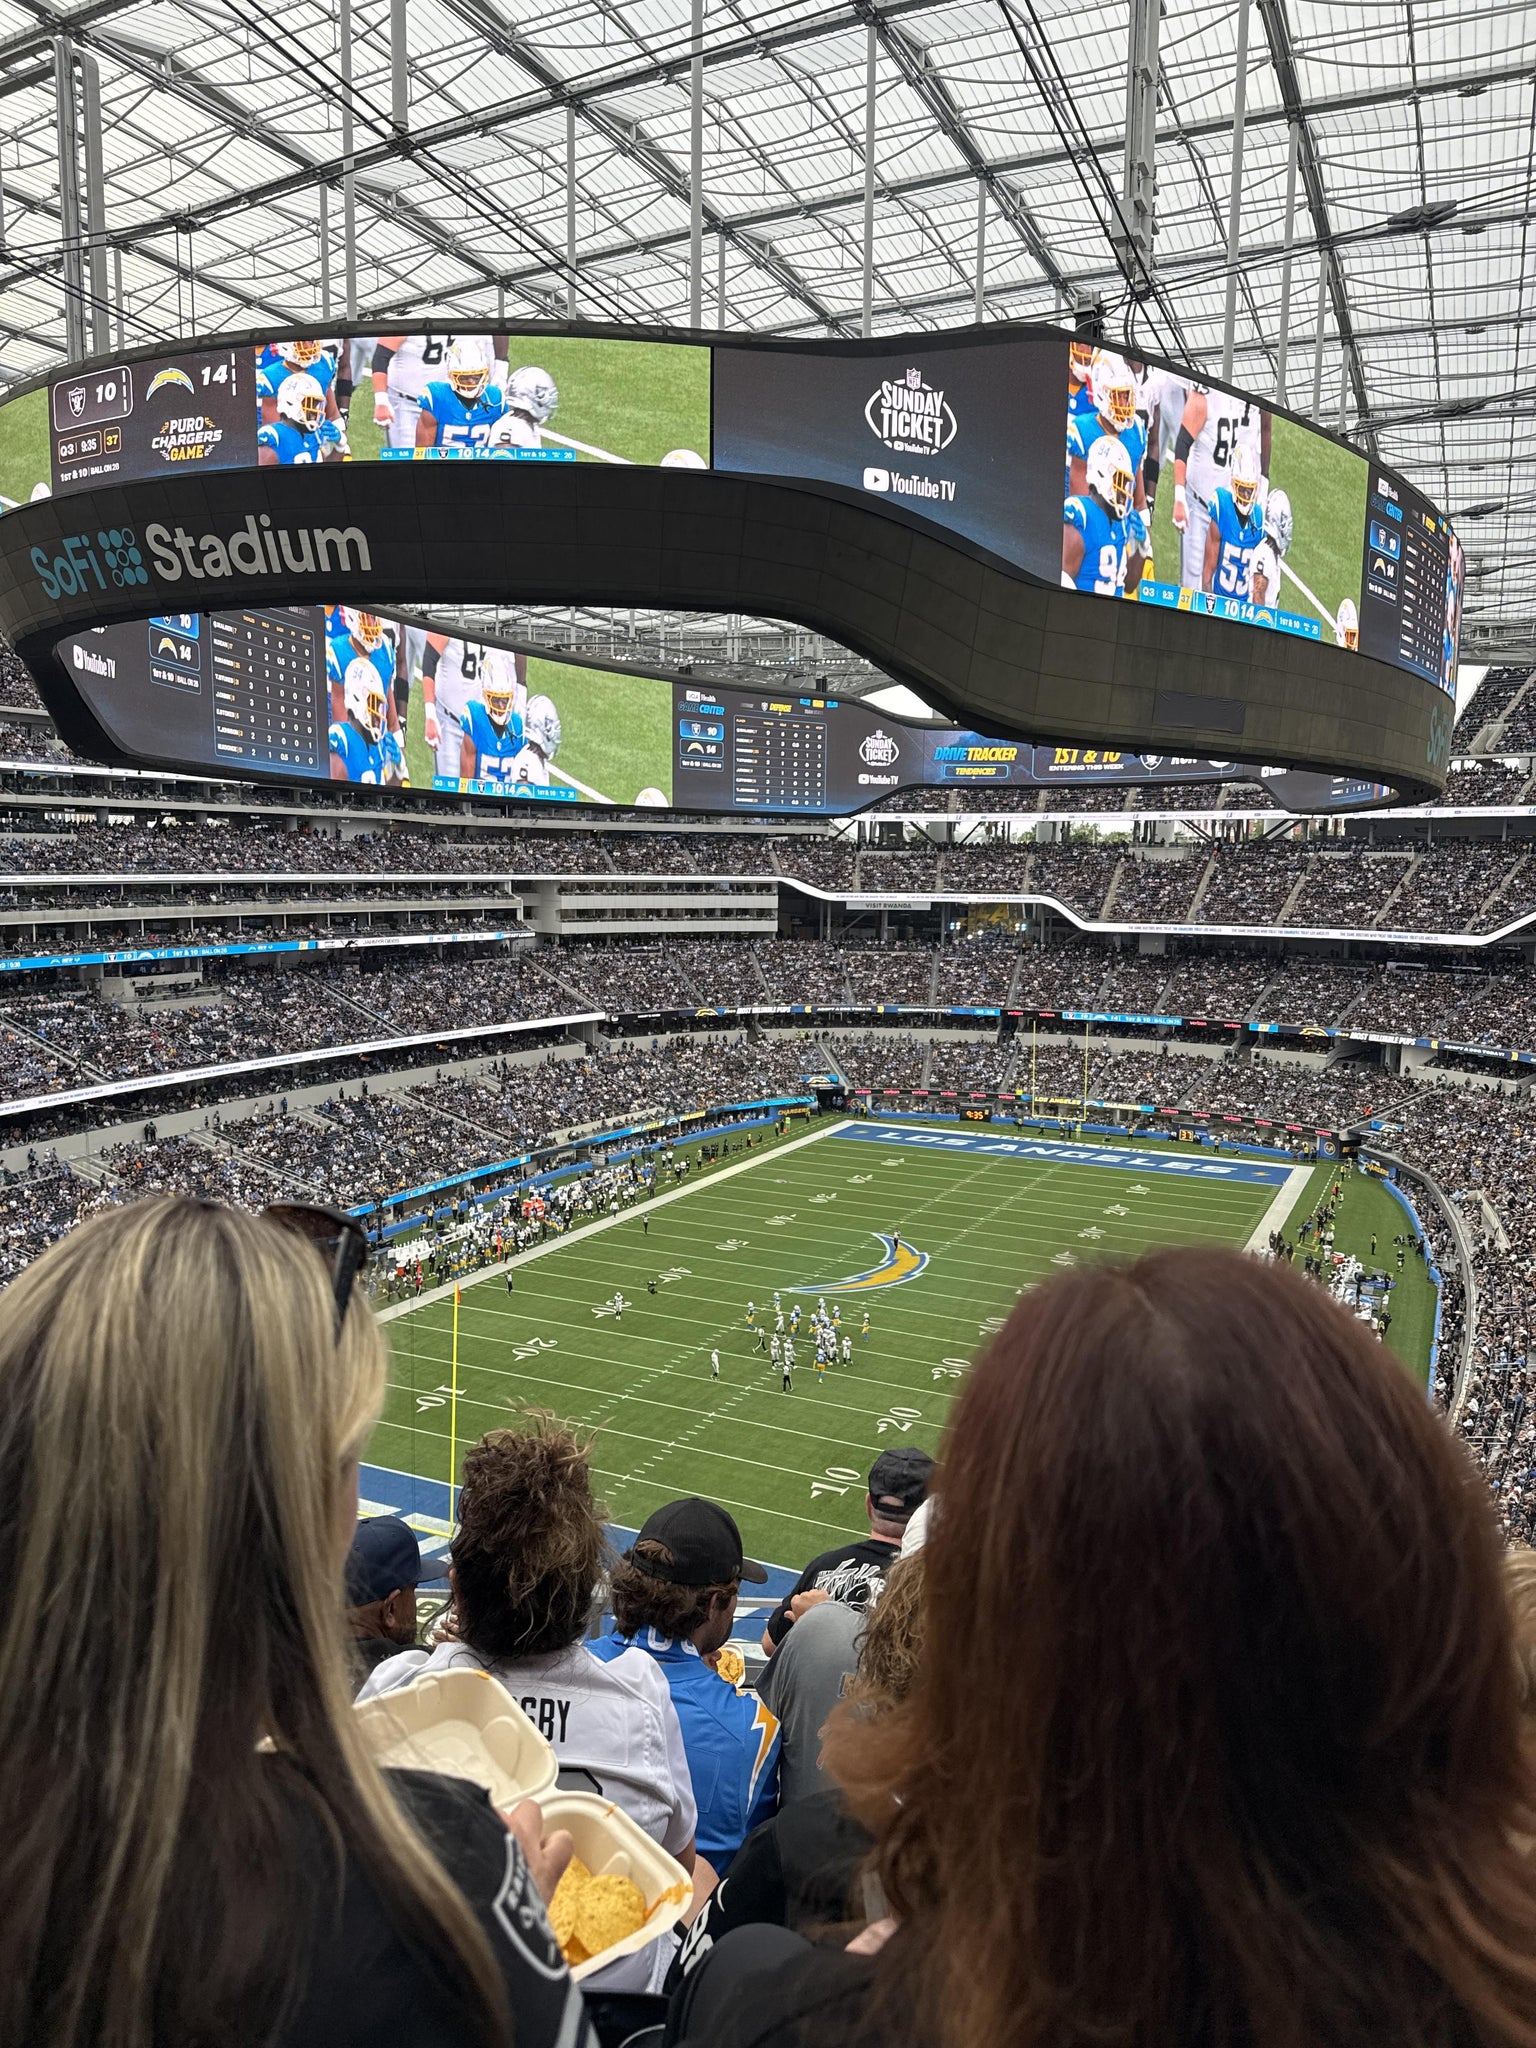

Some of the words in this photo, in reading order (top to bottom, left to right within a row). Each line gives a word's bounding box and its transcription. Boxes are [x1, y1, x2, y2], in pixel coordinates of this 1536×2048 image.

[201, 364, 228, 386] 14
[96, 382, 117, 403] 10
[881, 380, 945, 417] SUNDAY
[169, 417, 204, 433] PURO
[881, 407, 944, 448] TICKET
[106, 434, 119, 446] 37
[151, 429, 223, 450] CHARGERS
[60, 444, 74, 457] Q3
[170, 445, 205, 461] GAME
[457, 448, 472, 458] 10
[475, 448, 490, 459] 14
[60, 473, 72, 482] 1ST
[72, 469, 78, 479] &
[79, 467, 88, 477] 10
[890, 472, 939, 499] YouTube
[940, 480, 956, 501] TV
[30, 534, 107, 600] SoFi
[145, 513, 372, 582] Stadium
[1218, 545, 1251, 595] 53
[1142, 586, 1155, 597] Q3
[1181, 594, 1190, 604] 37
[1224, 600, 1238, 617] 10
[1241, 604, 1255, 620] 14
[180, 613, 191, 629] 10
[1293, 620, 1300, 629] 10
[180, 644, 192, 661] 14
[83, 649, 107, 678] YouTube
[106, 658, 116, 679] TV
[699, 704, 725, 716] CENTER
[706, 726, 717, 736] 10
[706, 745, 717, 754] 14
[865, 736, 893, 750] SUNDAY
[865, 748, 893, 763] TICKET
[967, 747, 1017, 761] TRACKER
[1054, 747, 1078, 764] 1ST
[1083, 748, 1097, 763] &
[955, 767, 997, 776] TENDENCIES
[1049, 763, 1086, 772] ENTERING
[1086, 763, 1103, 771] THIS
[1103, 763, 1124, 771] WEEK
[890, 775, 899, 785] TV
[492, 782, 503, 794] 10
[504, 783, 516, 795] 14
[1350, 1032, 1368, 1041] MOST
[1368, 1033, 1399, 1044] VALUABLE
[1399, 1036, 1415, 1046] PUPS
[1049, 1097, 1082, 1106] ANGELES
[1103, 1102, 1140, 1111] CHARGERS
[679, 1111, 706, 1121] CHARGERS
[778, 1107, 810, 1116] CHARGERS
[966, 1110, 983, 1119] 9:35
[1285, 1124, 1303, 1132] verizon
[1314, 1129, 1333, 1137] verizon
[1180, 1131, 1193, 1140] 37
[877, 1132, 977, 1145] LOS
[977, 1143, 1238, 1174] ANGELES
[715, 1239, 749, 1251] 50
[658, 1267, 692, 1281] 40
[512, 1337, 558, 1357] 20
[931, 1358, 972, 1378] 30
[416, 1385, 467, 1407] 10
[876, 1407, 922, 1432] 20
[810, 1467, 861, 1496] 10
